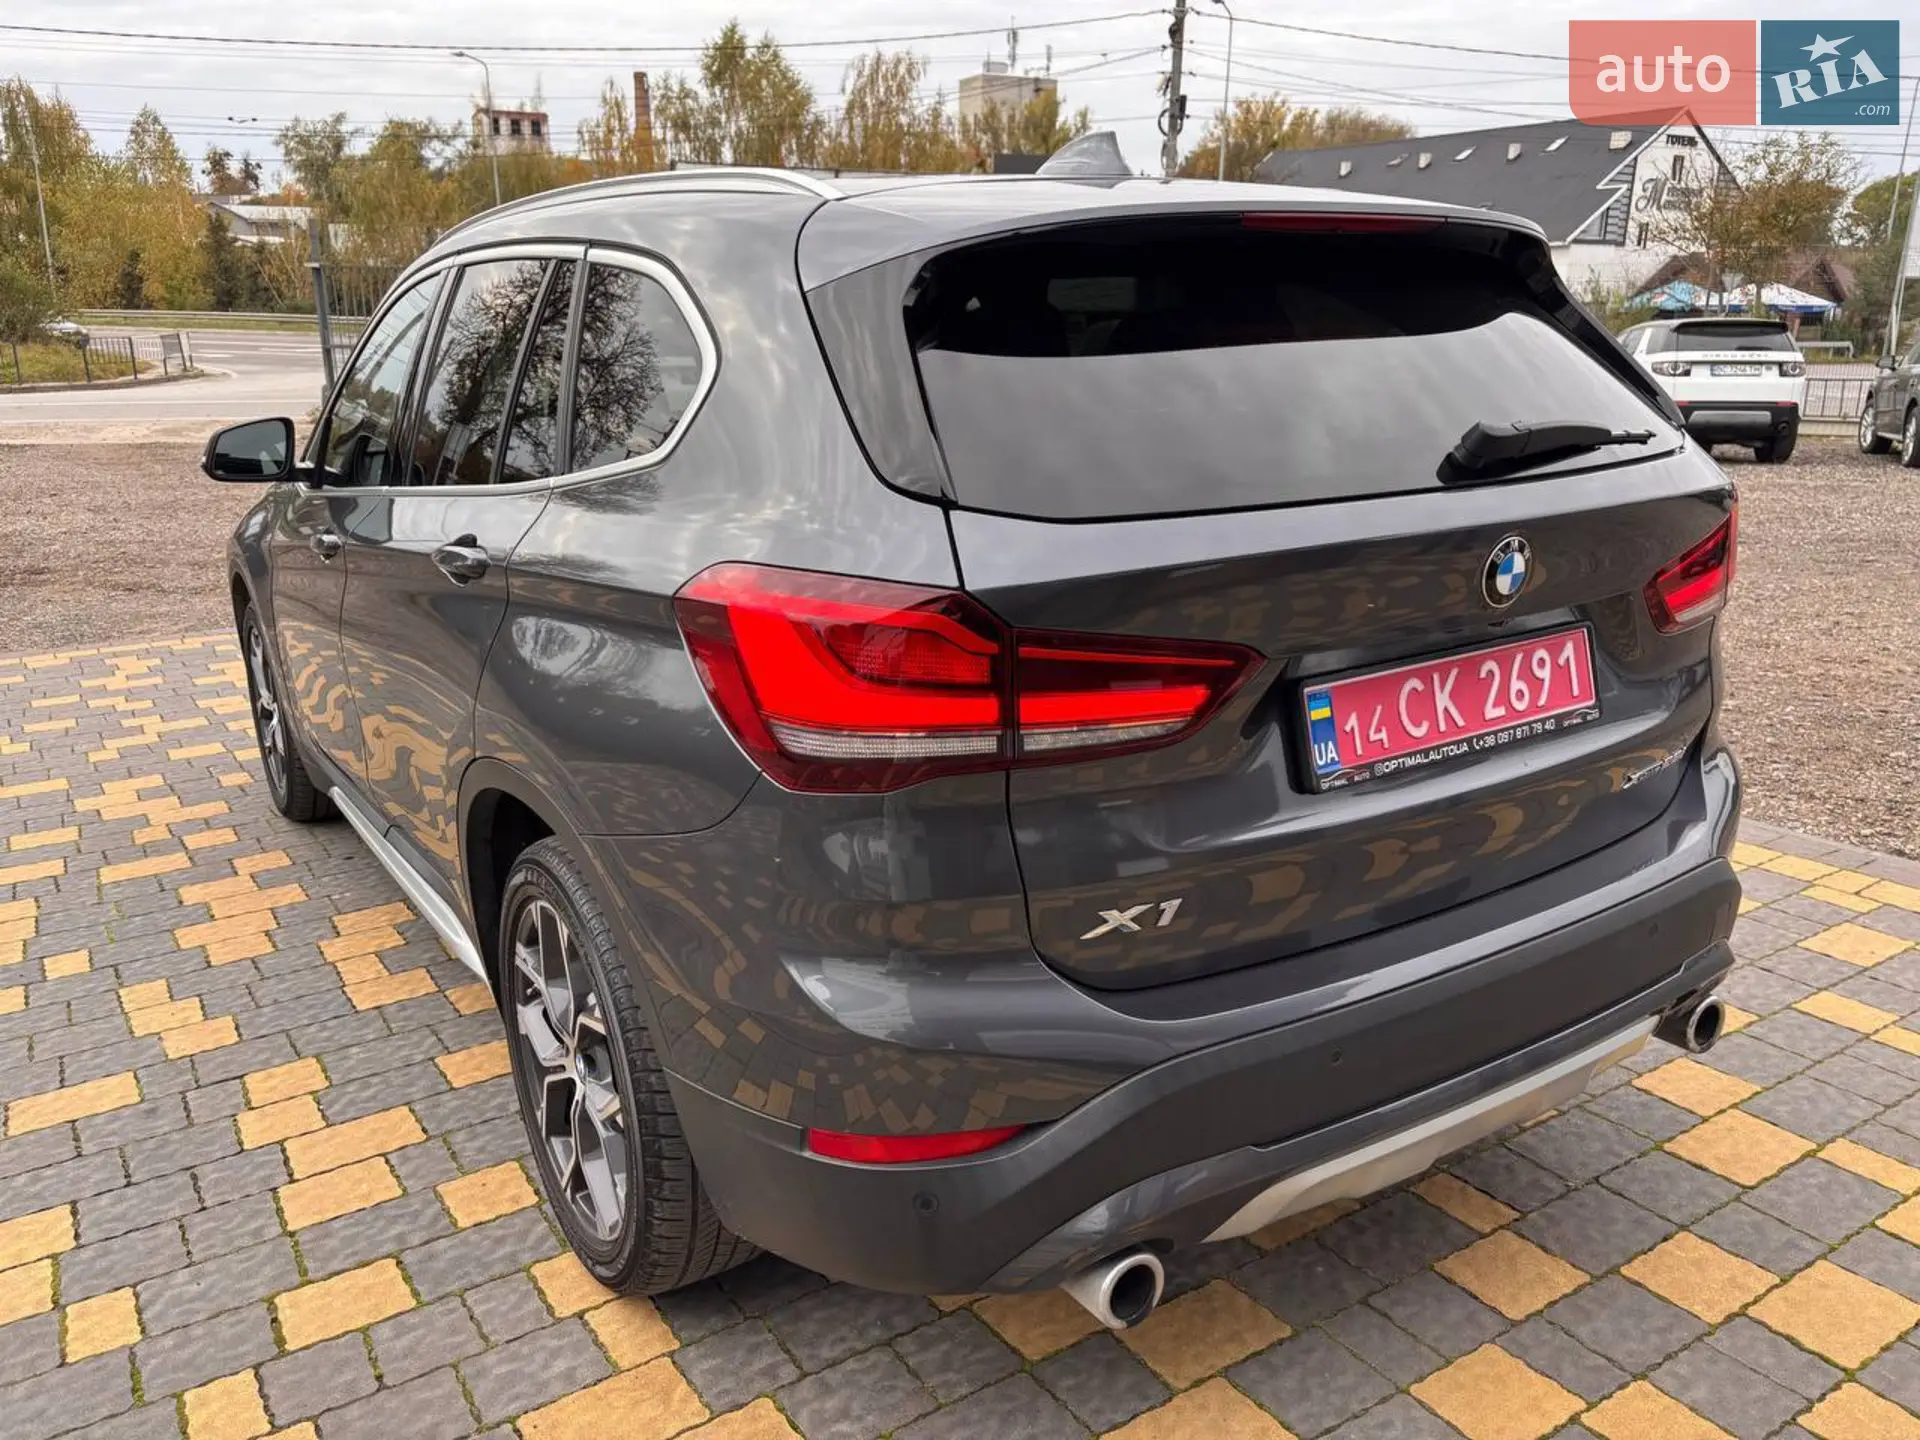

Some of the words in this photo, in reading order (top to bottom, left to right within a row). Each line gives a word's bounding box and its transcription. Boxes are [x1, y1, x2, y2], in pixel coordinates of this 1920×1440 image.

[1493, 539, 1531, 564] BMW
[1344, 704, 1390, 756] 14
[1399, 669, 1466, 738] CK
[1479, 639, 1581, 721] 2691
[1516, 725, 1530, 739] 871
[1544, 719, 1555, 730] 40
[1314, 740, 1339, 765] UA
[1080, 898, 1183, 940] X1
